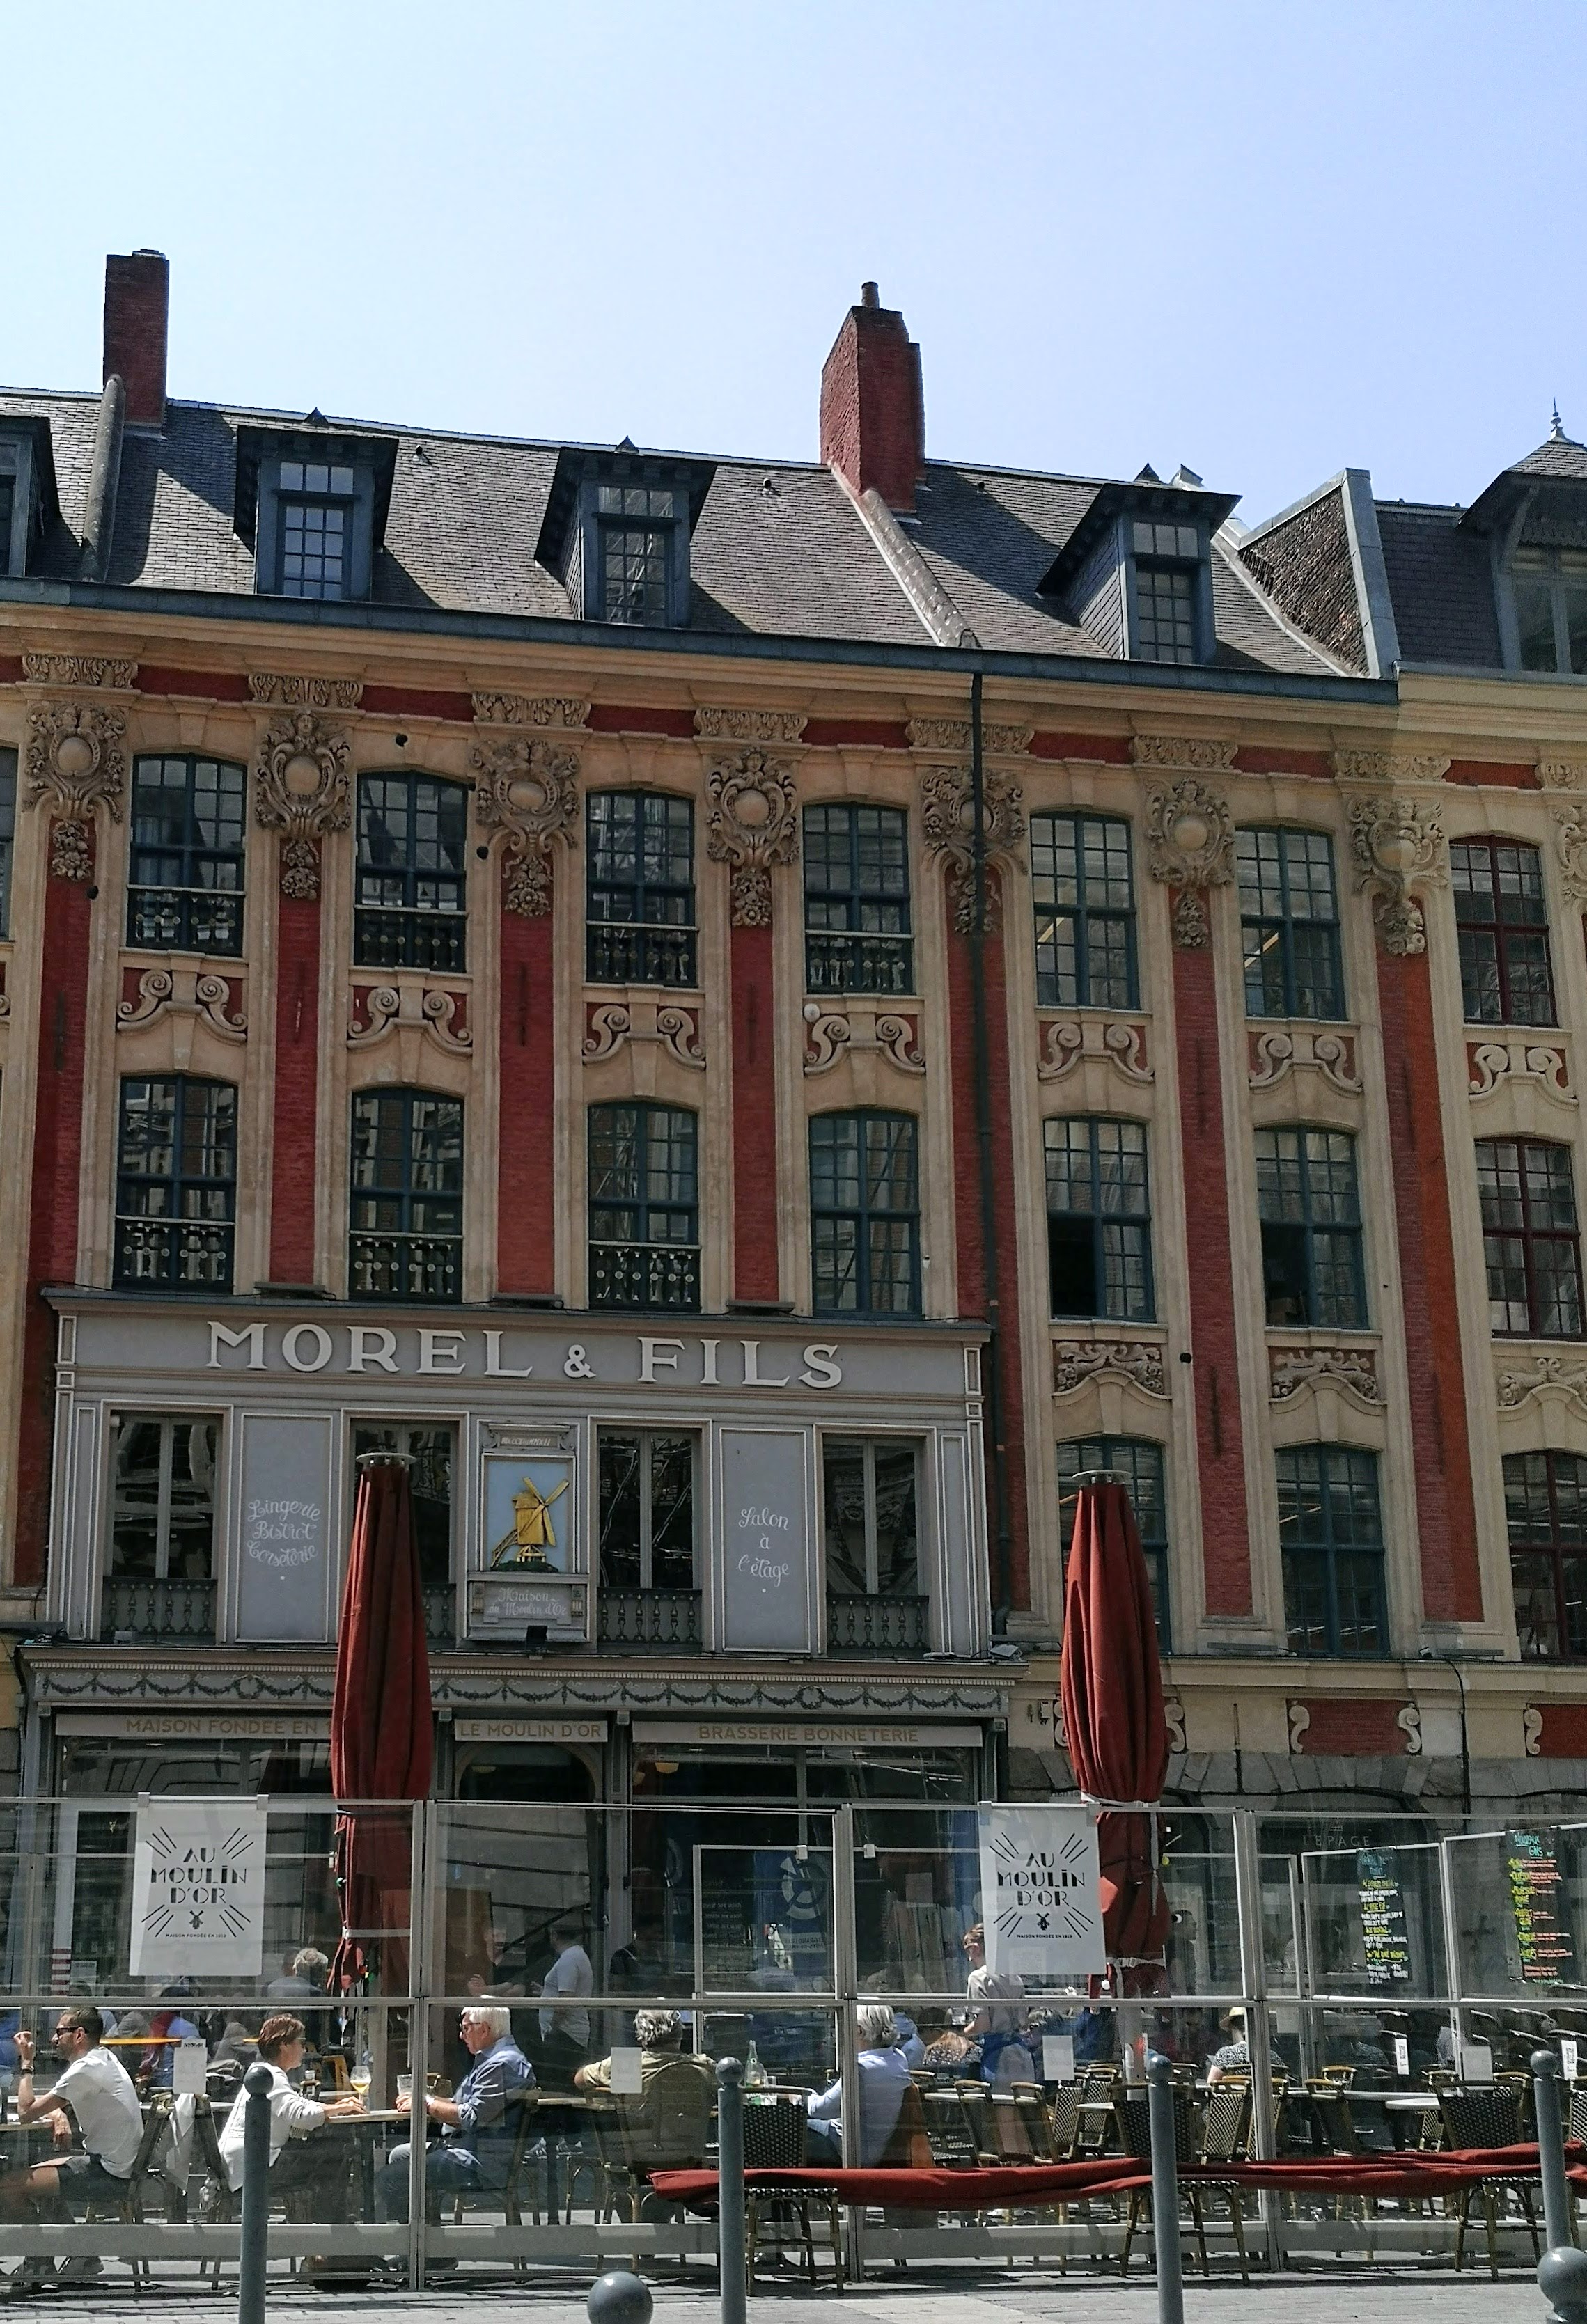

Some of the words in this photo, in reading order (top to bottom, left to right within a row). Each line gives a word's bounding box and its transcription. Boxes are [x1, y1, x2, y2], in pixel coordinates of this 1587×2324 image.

[206, 1321, 533, 1379] MOREL
[563, 1344, 596, 1379] &
[637, 1337, 842, 1388] FILS
[248, 1500, 320, 1521] Lingerie
[738, 1507, 788, 1530] Salon
[252, 1521, 317, 1539] Bistrot
[759, 1533, 769, 1549] à
[247, 1540, 318, 1567] Corseterie
[497, 1587, 549, 1602] Maison
[487, 1603, 499, 1614] du
[504, 1602, 542, 1615] Moulin
[126, 1718, 201, 1734] MAISON
[292, 1720, 318, 1734] EN
[460, 1723, 480, 1736] LE
[488, 1723, 555, 1738] MOULIN
[561, 1724, 601, 1738] D'OR
[698, 1726, 797, 1741] BRASSERIE
[804, 1727, 918, 1743] BONNETERIE
[183, 1848, 215, 1863] AU
[1026, 1853, 1054, 1867] AU
[171, 1887, 226, 1903] D'OR
[1017, 1890, 1069, 1906] D'OR
